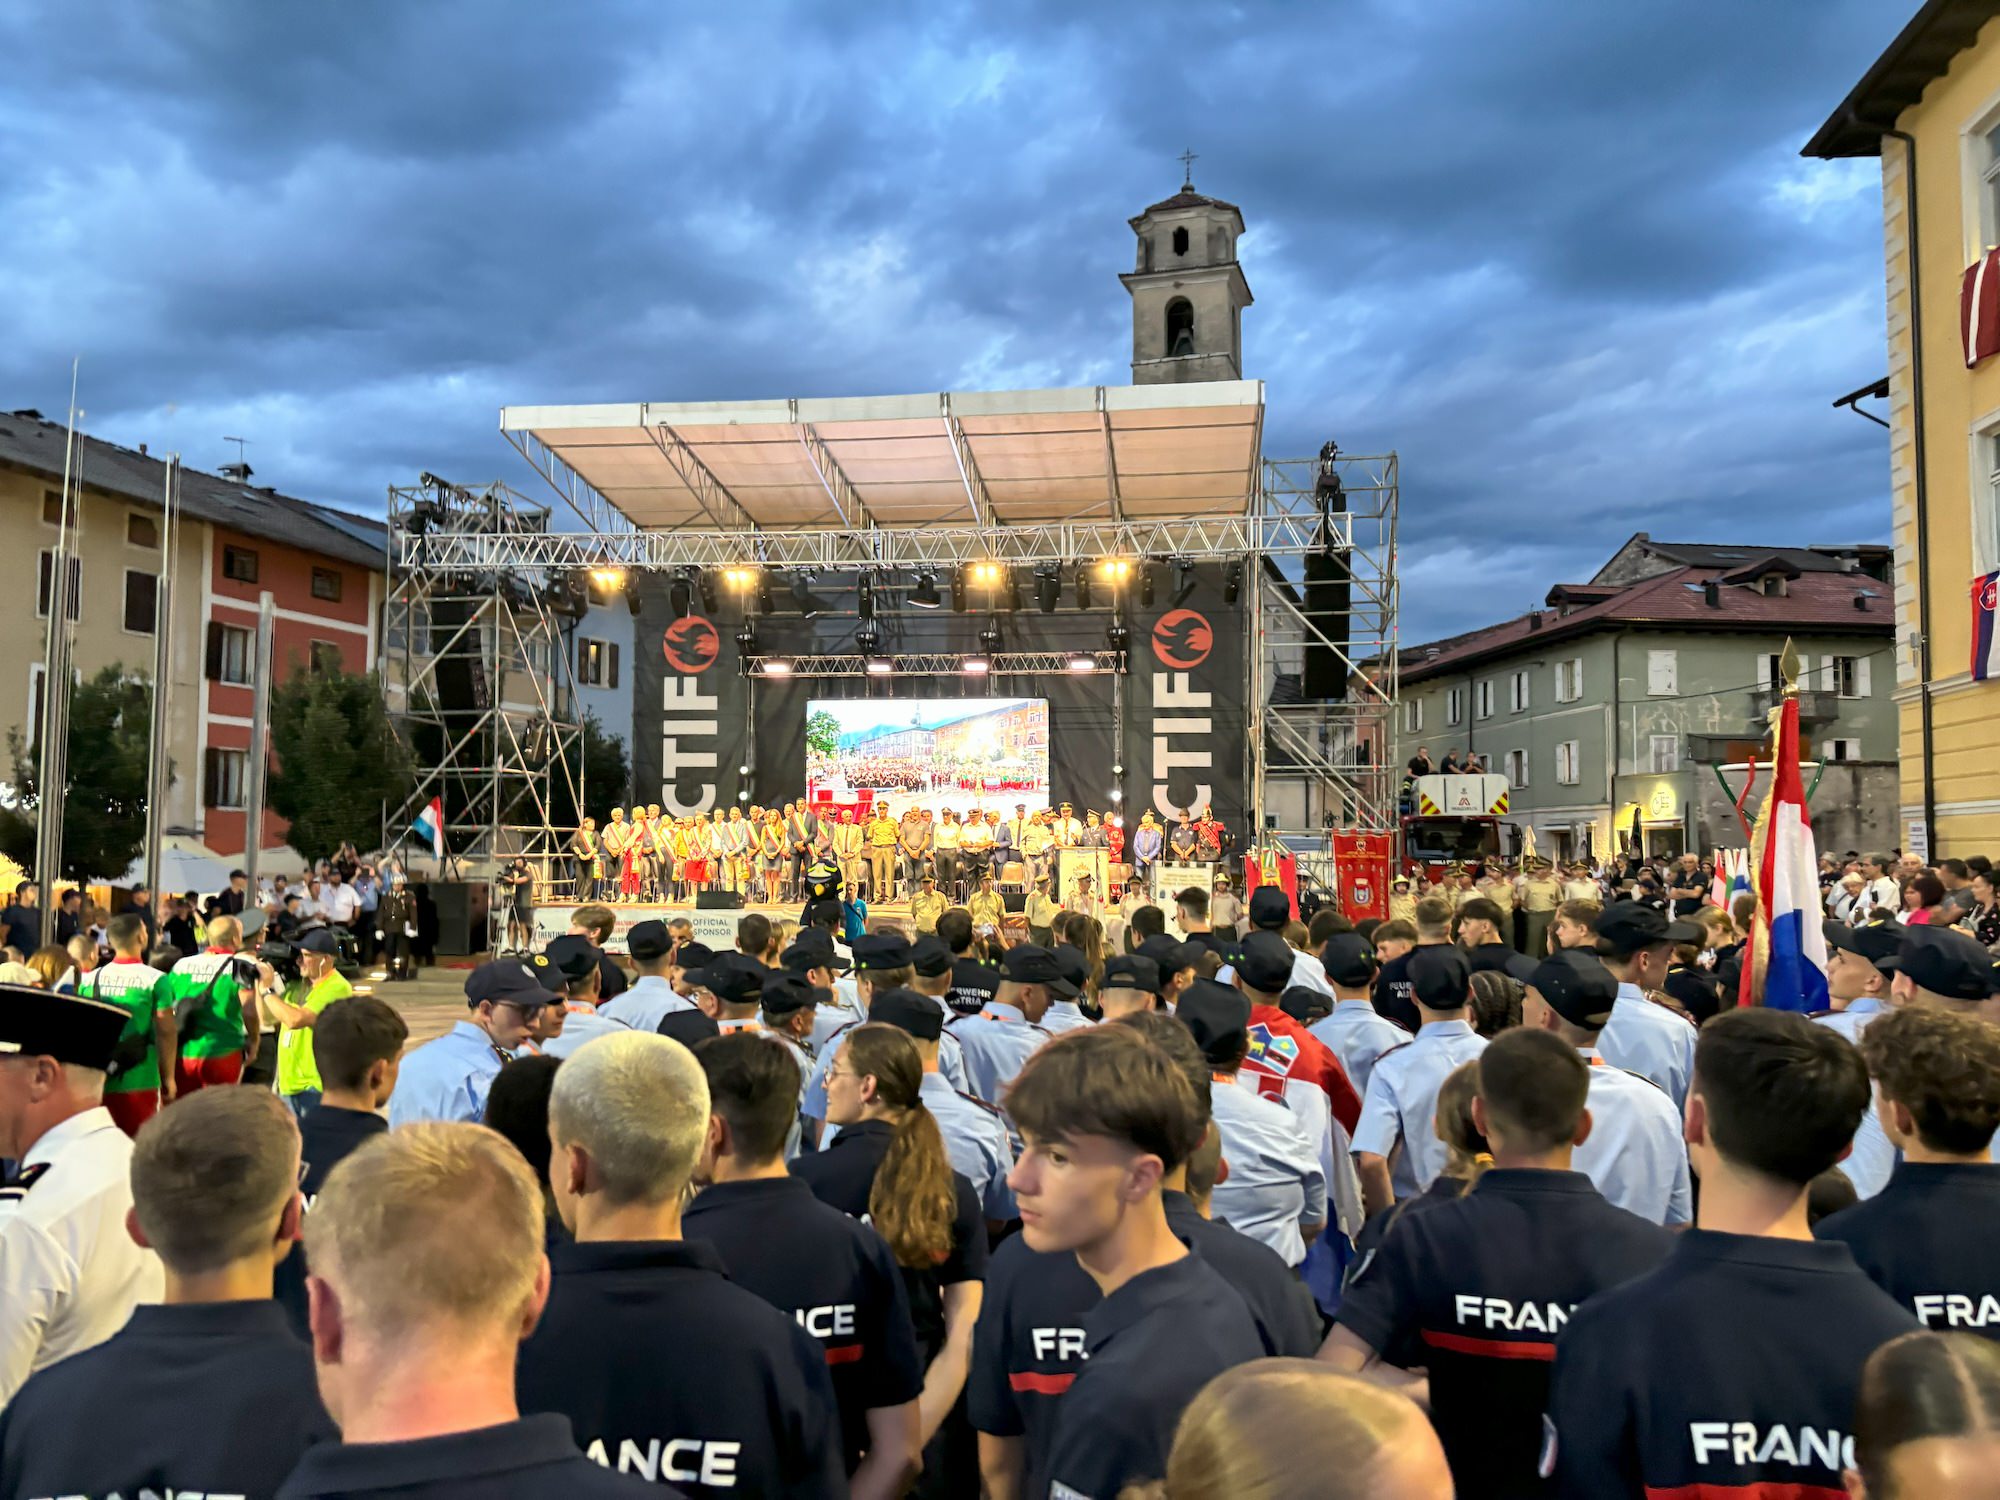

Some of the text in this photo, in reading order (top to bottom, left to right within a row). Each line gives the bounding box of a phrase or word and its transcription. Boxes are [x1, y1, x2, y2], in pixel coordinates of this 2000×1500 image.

[662, 676, 718, 818] CTIF
[1152, 672, 1212, 823] CTIF
[692, 918, 728, 926] OFFICIAL
[693, 928, 731, 936] SPONSOR
